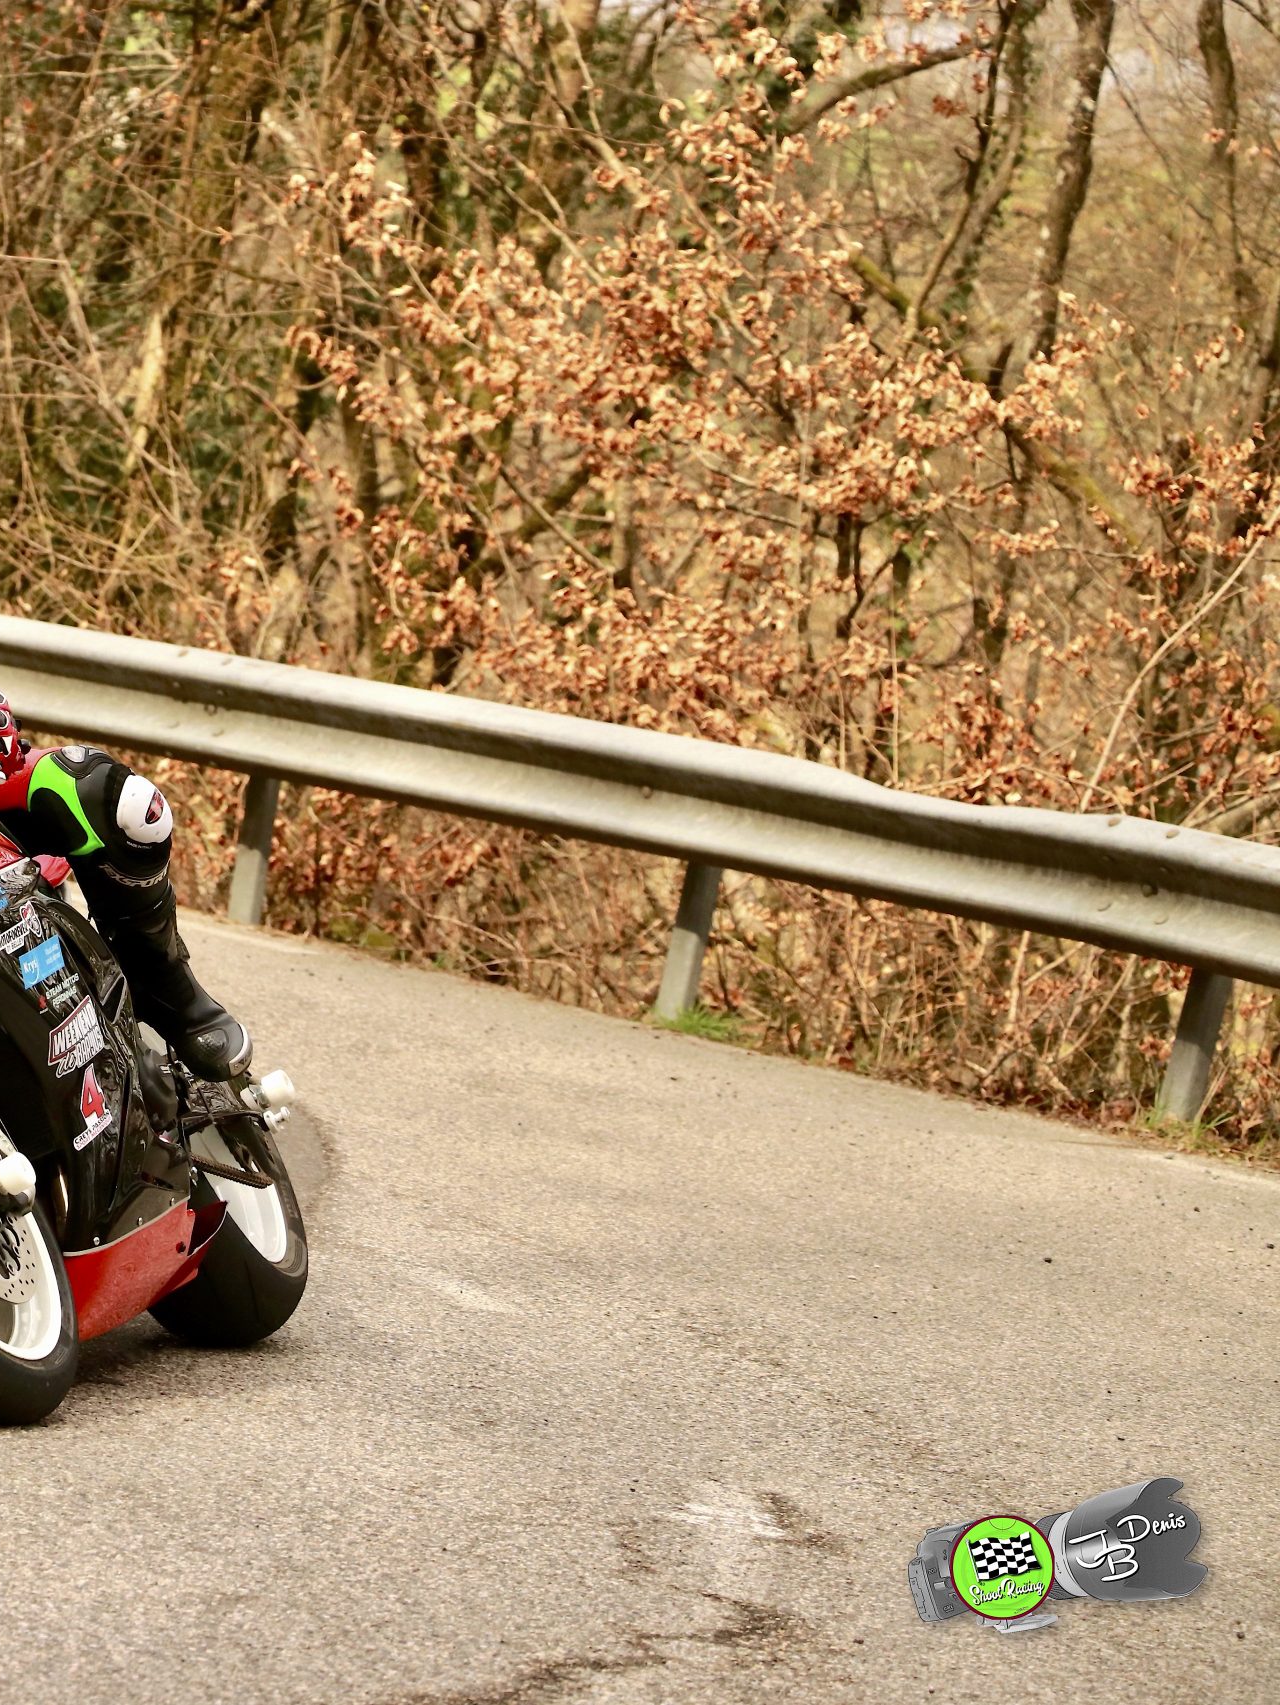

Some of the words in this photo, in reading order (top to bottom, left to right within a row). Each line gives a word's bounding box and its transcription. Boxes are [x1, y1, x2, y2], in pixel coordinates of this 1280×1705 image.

[23, 956, 38, 974] Krys
[61, 973, 80, 991] MOTOS
[52, 1001, 97, 1056] WEEKEND
[57, 1049, 77, 1075] de
[81, 1064, 106, 1119] 4
[74, 1129, 93, 1144] CREYS
